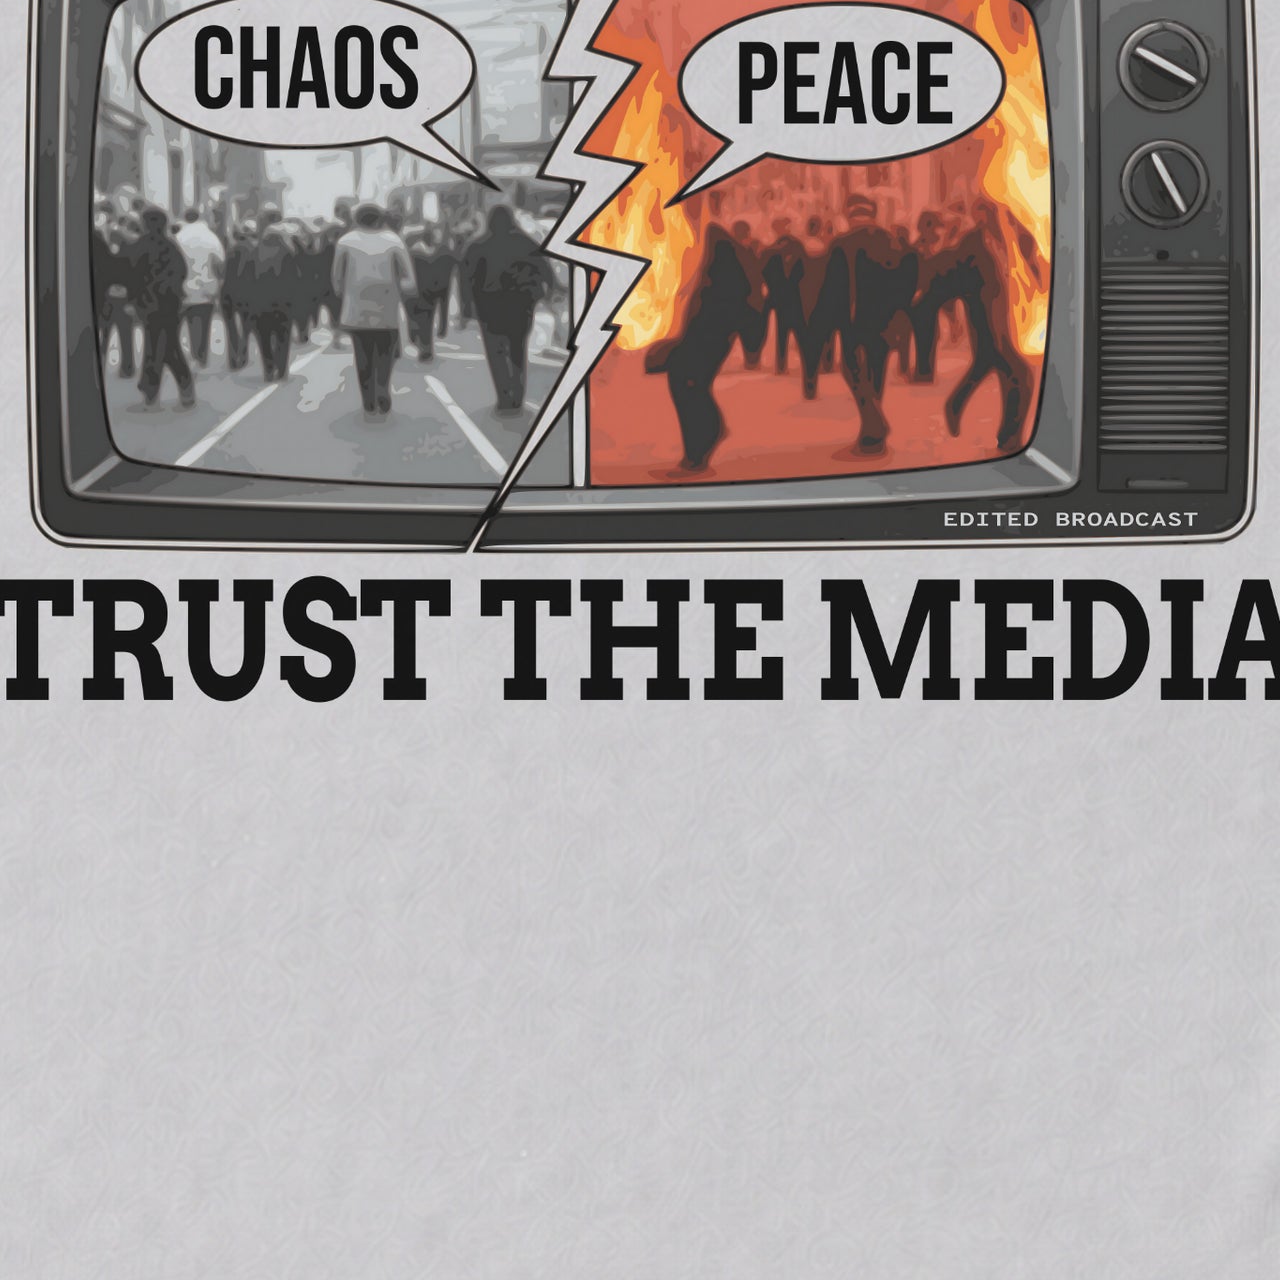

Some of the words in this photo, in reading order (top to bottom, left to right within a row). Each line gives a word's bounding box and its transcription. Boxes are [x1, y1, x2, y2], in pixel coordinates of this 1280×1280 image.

[193, 24, 420, 110] CHAOS
[737, 39, 954, 125] PEACE
[943, 512, 1039, 527] EDITED
[1055, 512, 1199, 527] BROADCAST
[480, 579, 784, 701] THE
